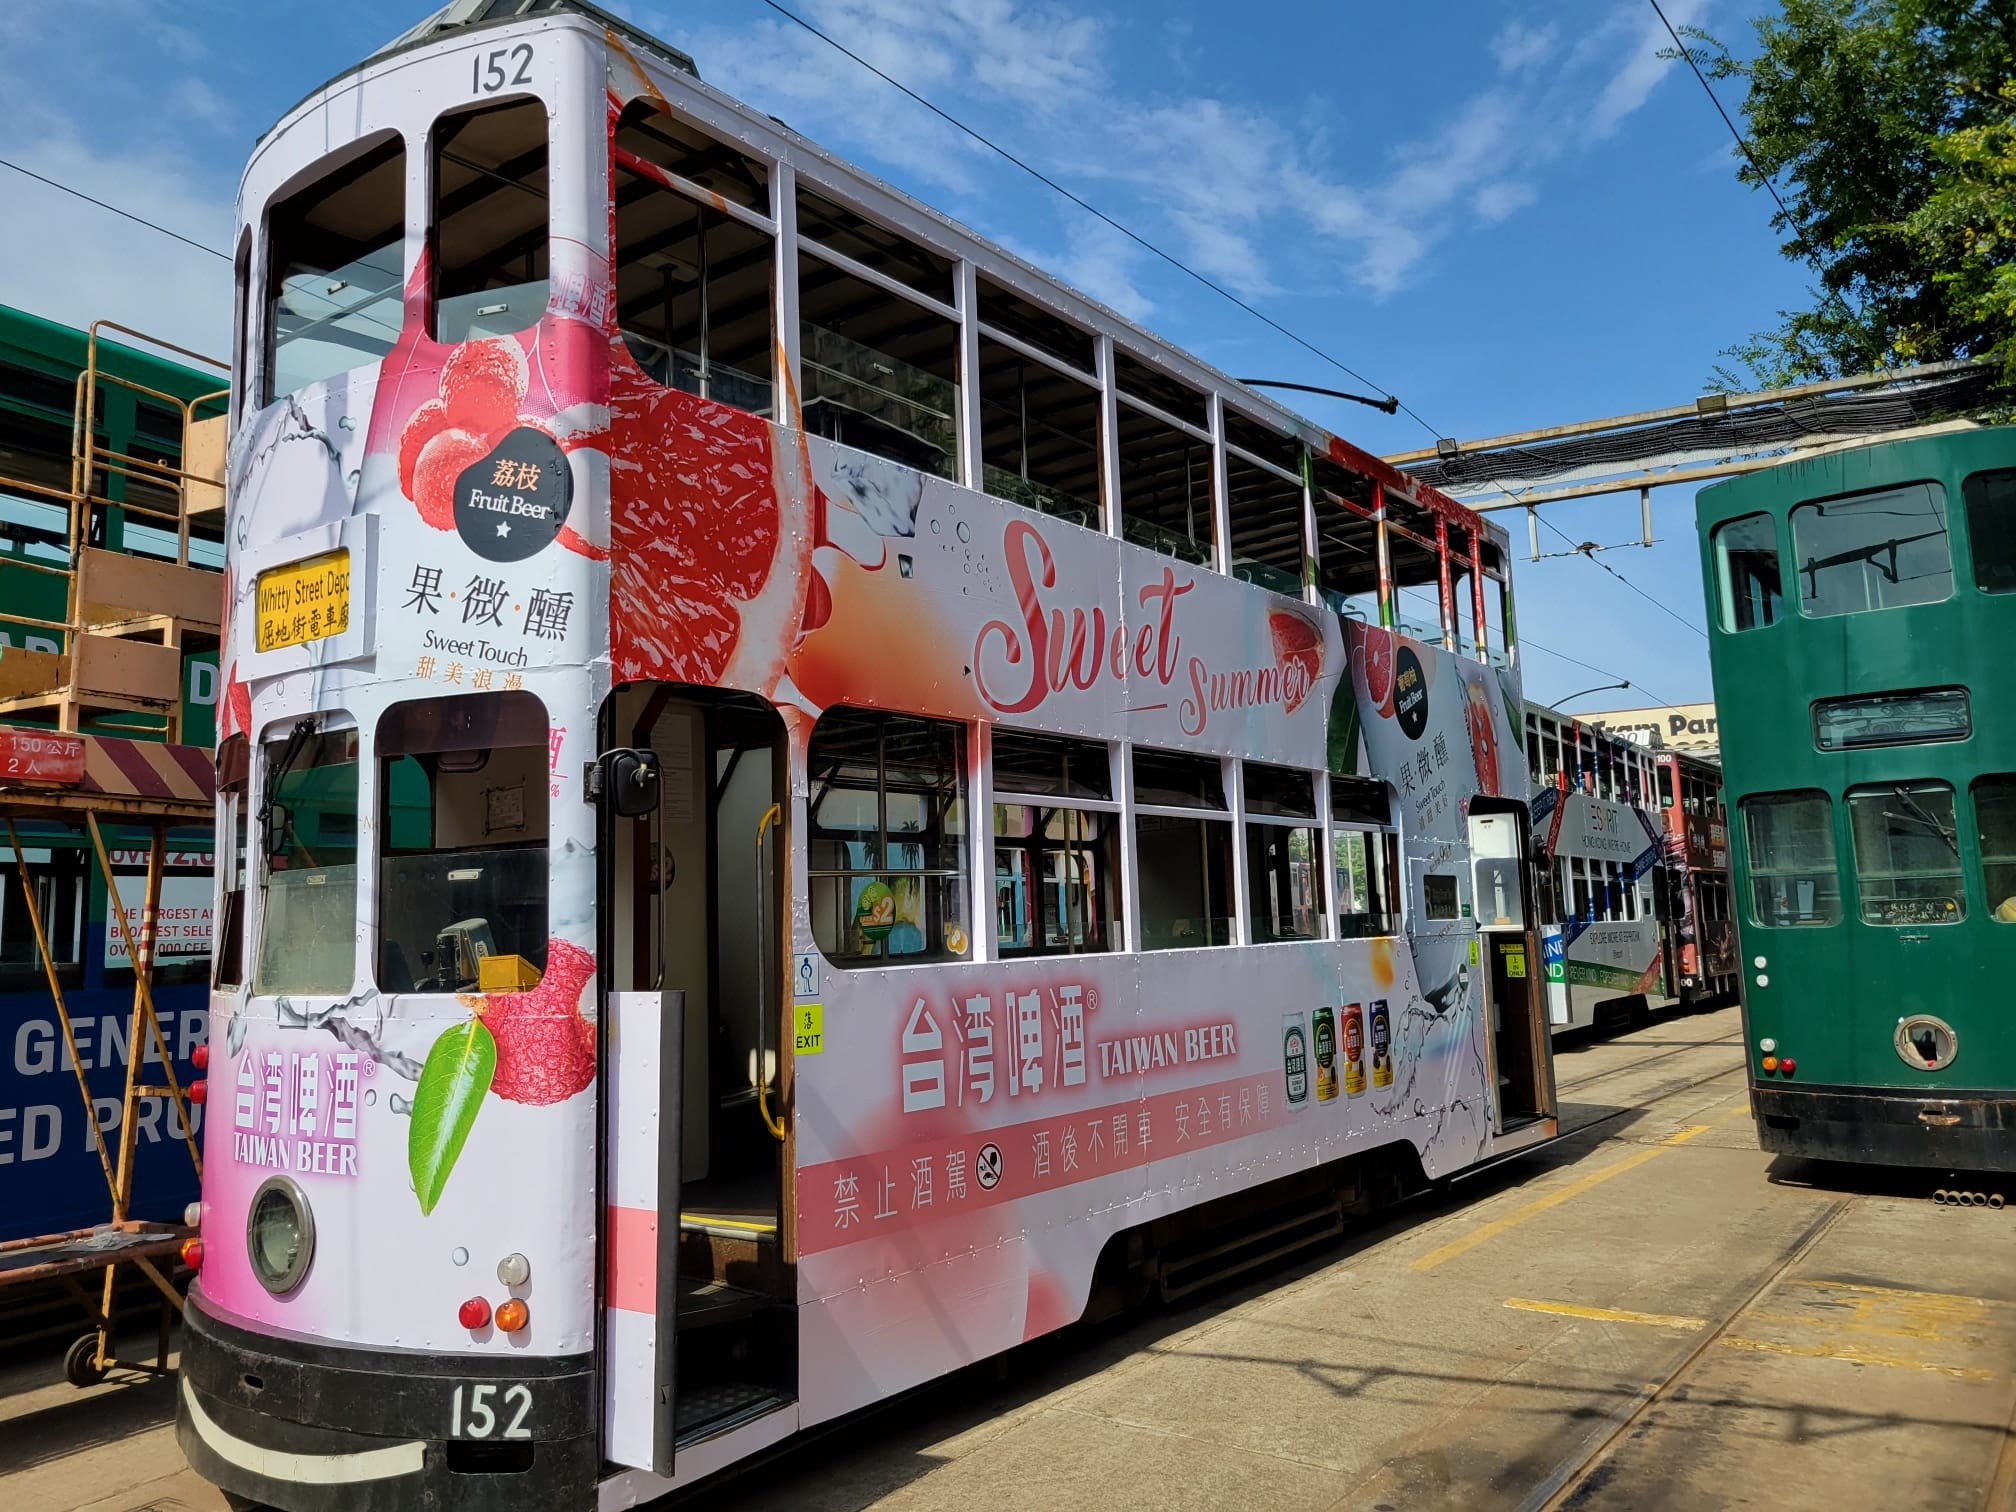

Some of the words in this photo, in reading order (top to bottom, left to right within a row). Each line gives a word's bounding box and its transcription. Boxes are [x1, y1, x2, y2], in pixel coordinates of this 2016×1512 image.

[472, 43, 534, 94] 152
[490, 459, 542, 491] 荔枝
[468, 489, 510, 513] Fruit
[509, 497, 552, 520] Beer
[261, 586, 292, 613] Whitty
[295, 579, 324, 606] Street
[974, 520, 1195, 714] Sweet
[423, 629, 475, 657] Sweet
[477, 639, 528, 668] Touch
[1180, 656, 1311, 737] Summer
[11, 736, 42, 753] 150
[46, 740, 81, 758] 公斤
[1656, 754, 1672, 763] 100
[7, 758, 19, 773] 2
[24, 760, 41, 775] 人
[141, 908, 198, 920] LRGEST
[796, 1034, 821, 1049] EXIT
[1098, 1030, 1178, 1078] TAIWAN
[1183, 1023, 1238, 1064] BEER
[234, 1131, 291, 1169] TAIWAN
[296, 1140, 358, 1176] BEER
[833, 1149, 968, 1230] 禁止酒駕
[1032, 1110, 1154, 1180] 酒後不開車
[1175, 1083, 1271, 1144] 安全有保障
[451, 1384, 533, 1439] 152
